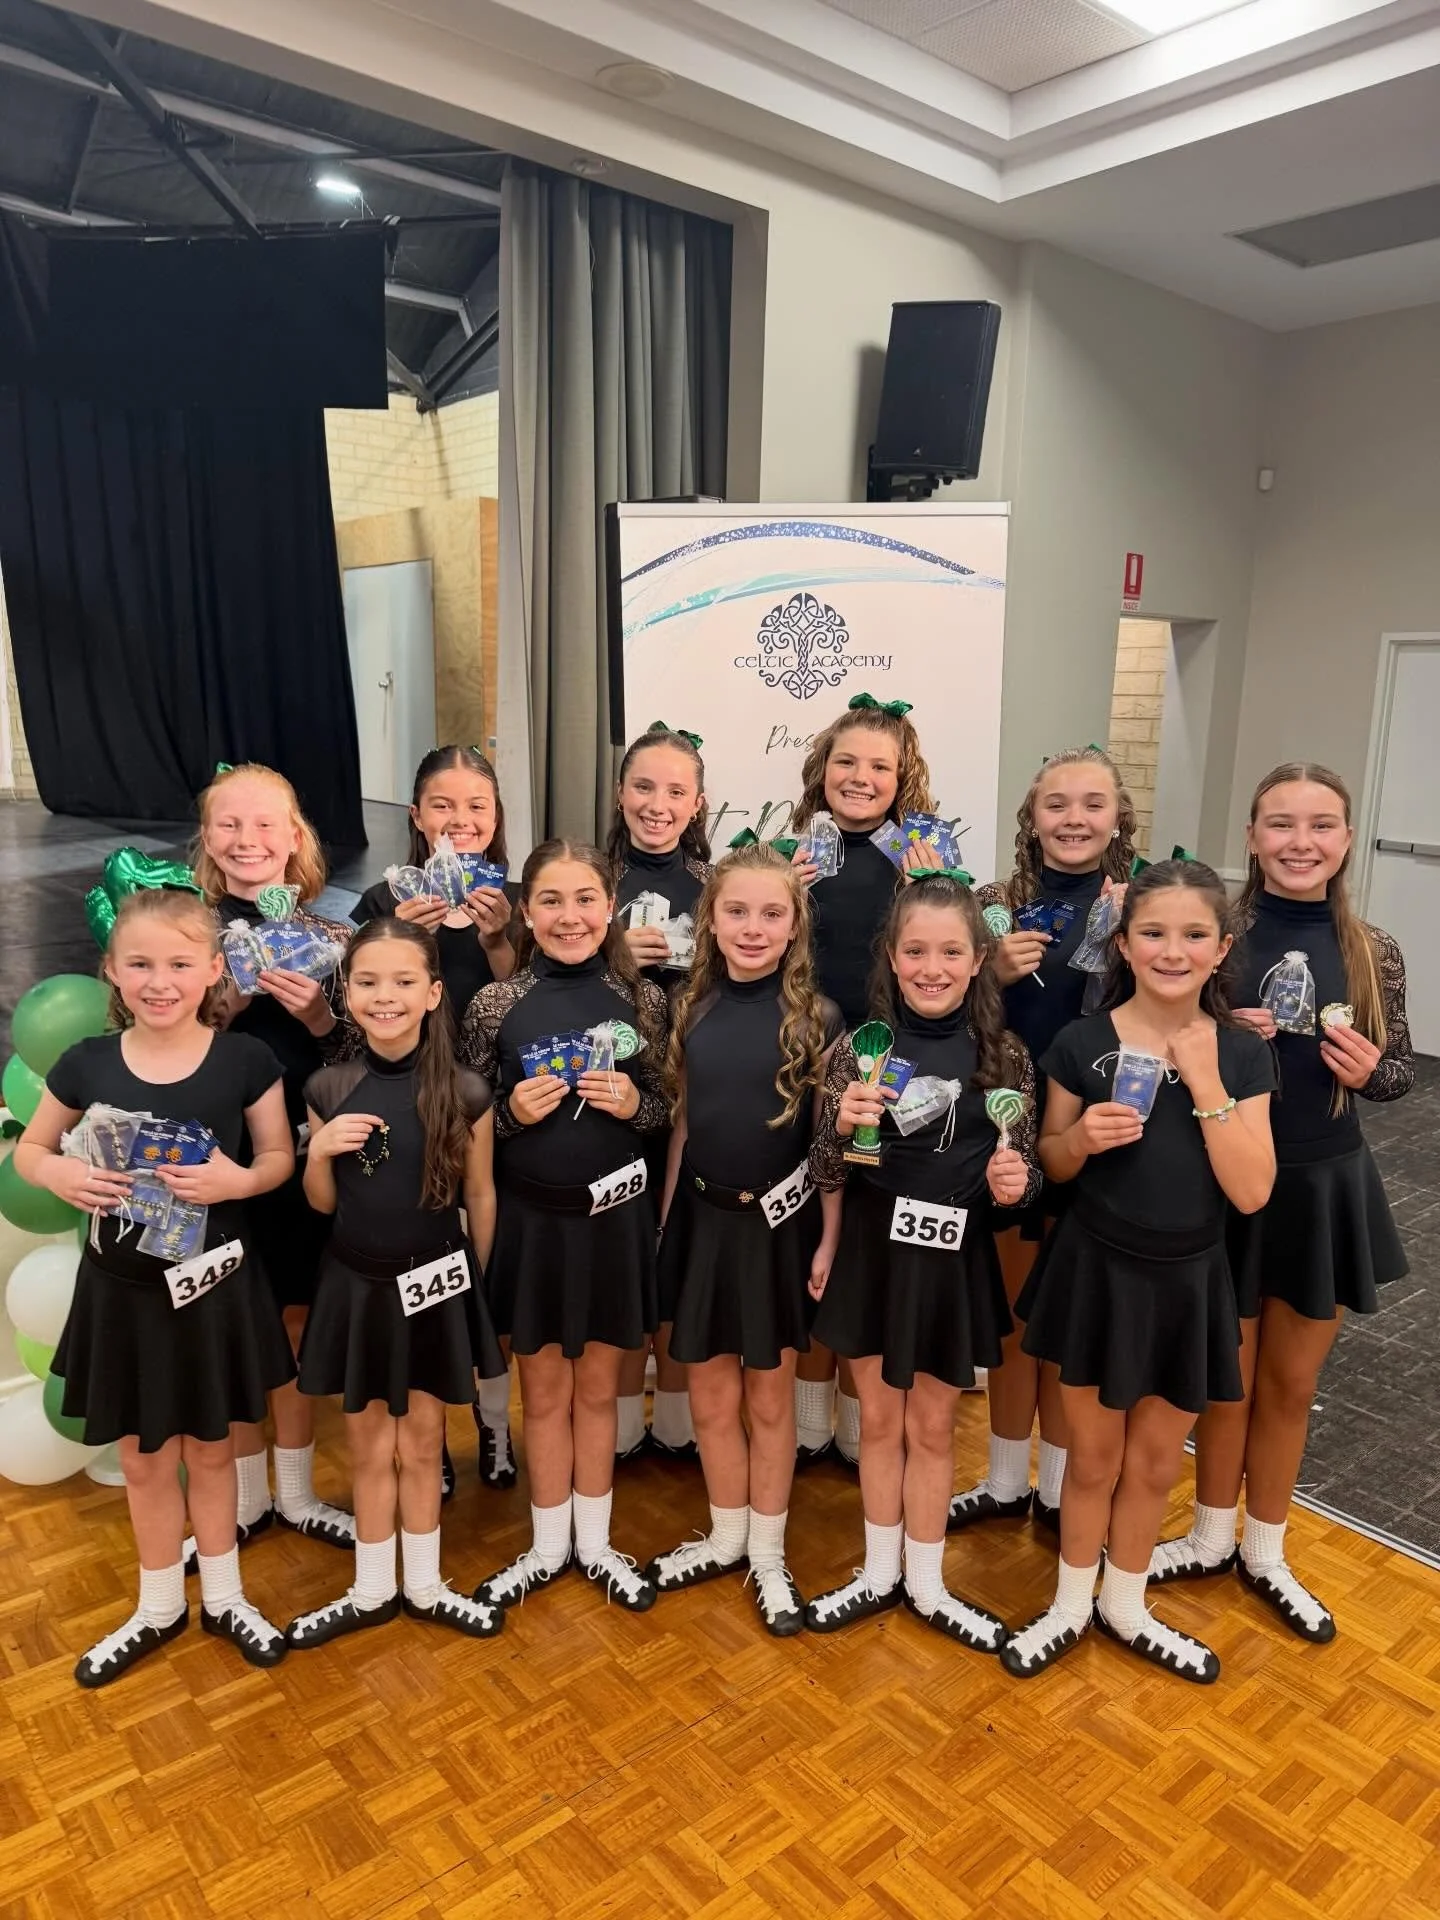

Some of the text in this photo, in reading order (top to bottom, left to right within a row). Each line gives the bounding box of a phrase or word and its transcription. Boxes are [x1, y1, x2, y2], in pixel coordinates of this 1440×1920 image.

[765, 724, 815, 755] Pres
[595, 1173, 643, 1209] 428
[768, 1171, 815, 1221] 354
[896, 1212, 960, 1245] 356
[405, 1264, 465, 1308] 345
